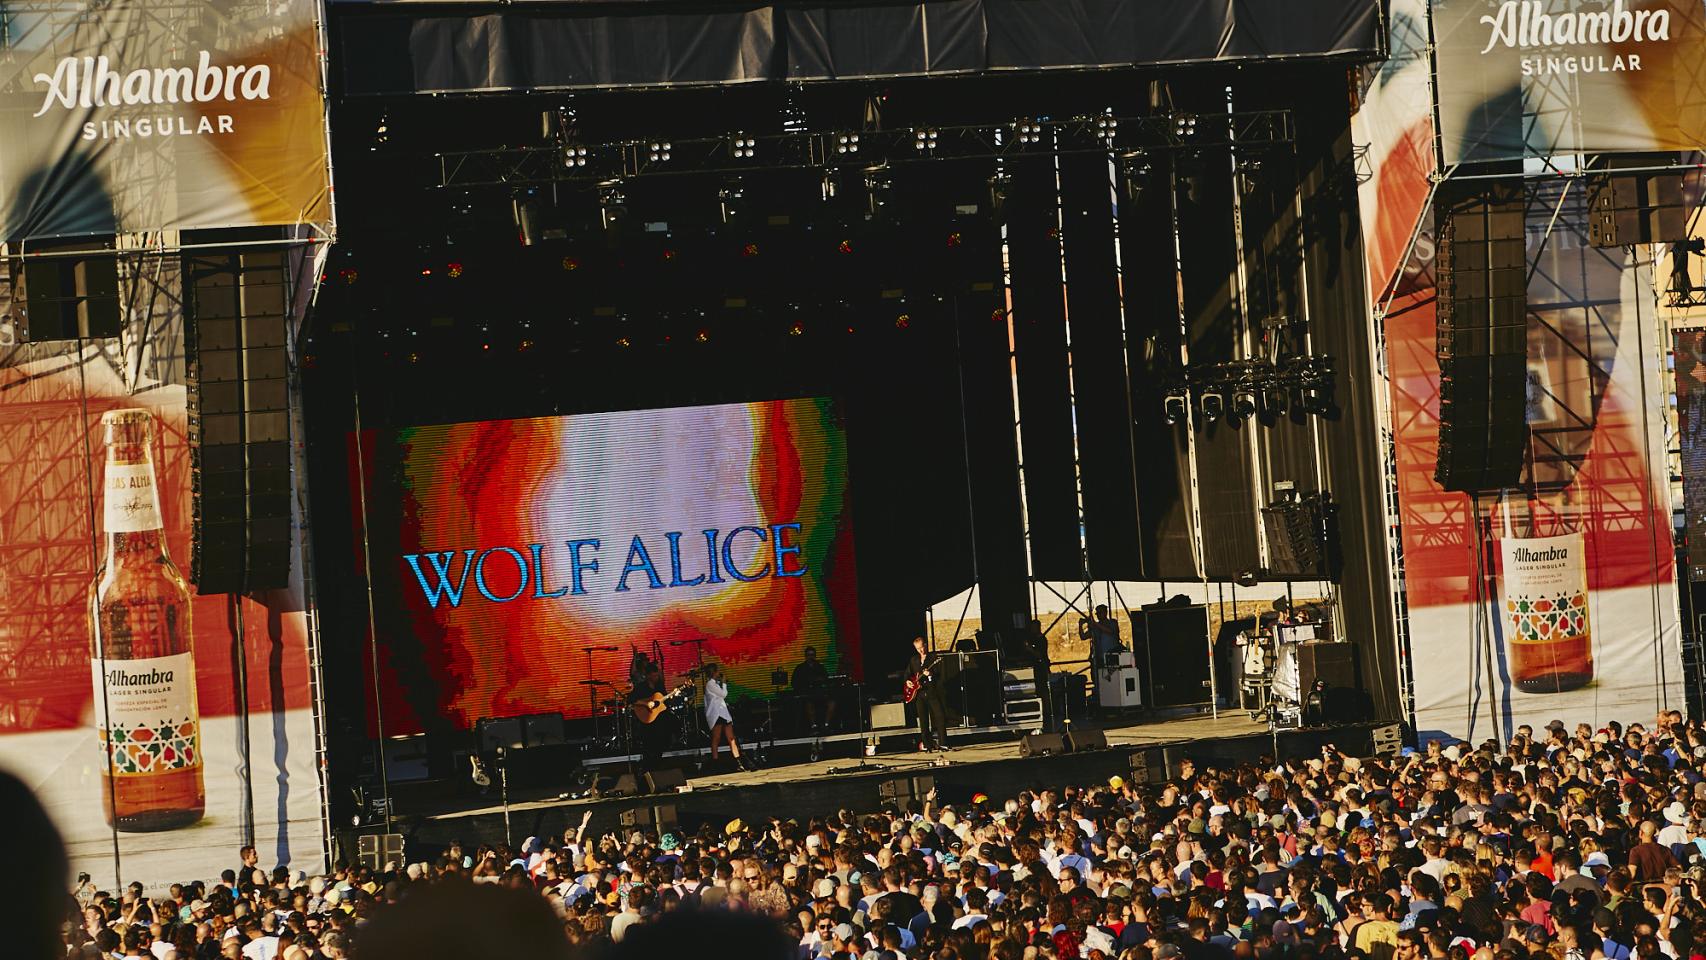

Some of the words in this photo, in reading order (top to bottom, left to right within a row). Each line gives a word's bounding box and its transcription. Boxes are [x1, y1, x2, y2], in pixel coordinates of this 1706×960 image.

[1480, 0, 1669, 54] Alhambra
[1521, 54, 1642, 76] SINGULAR
[33, 50, 271, 118] Alhambra
[83, 114, 235, 141] SINGULAR
[403, 538, 601, 609] WOLF
[615, 522, 809, 592] ALICE
[1512, 546, 1568, 563] Alhambra
[105, 668, 173, 686] Alhambra
[135, 687, 171, 695] SINGULAR
